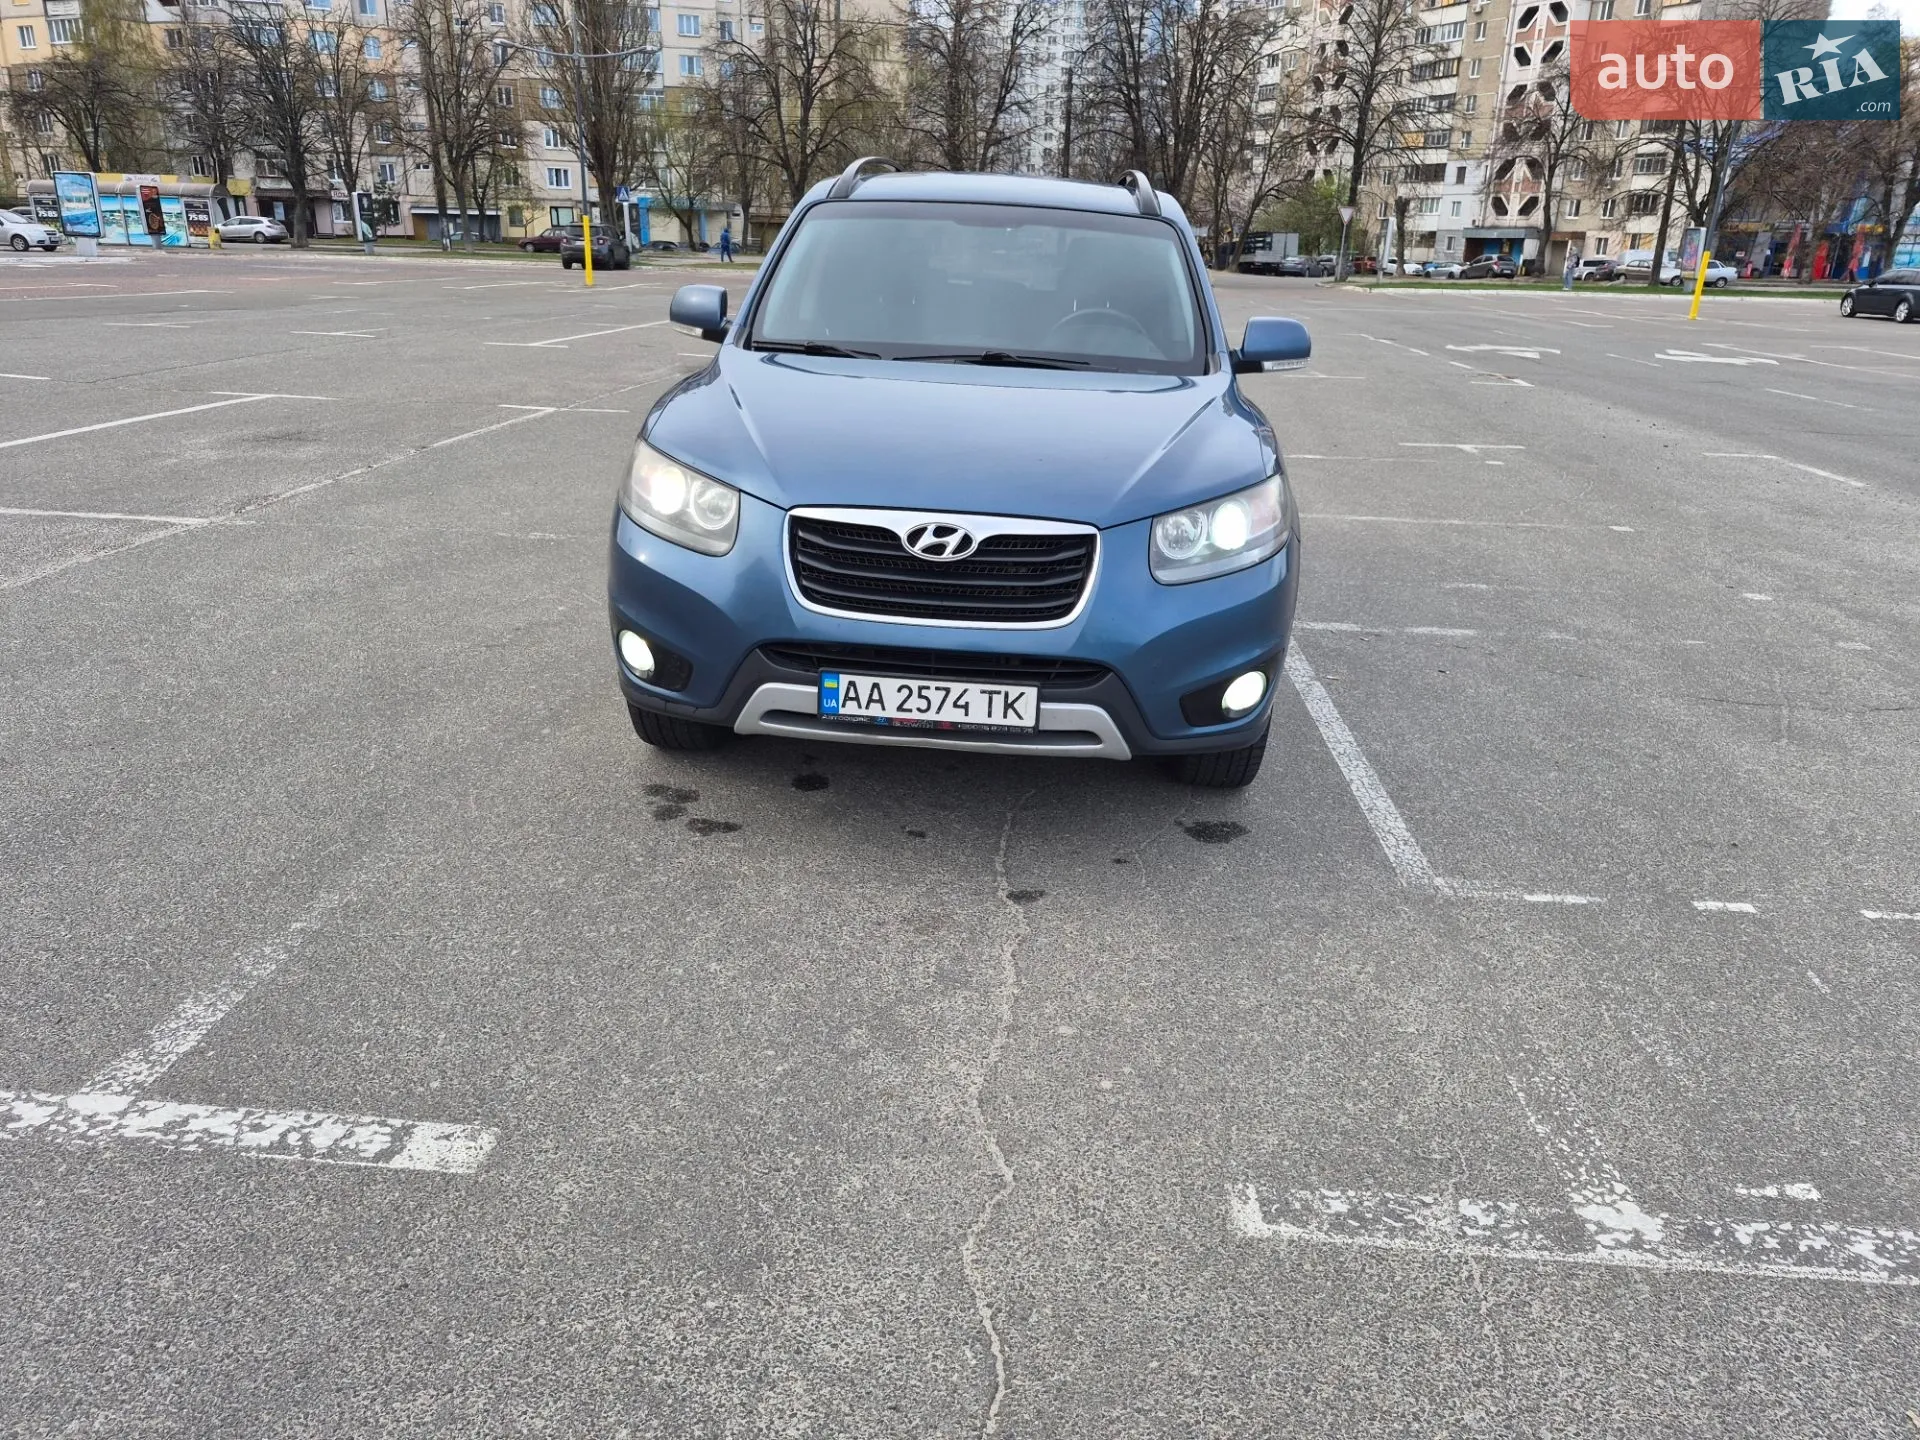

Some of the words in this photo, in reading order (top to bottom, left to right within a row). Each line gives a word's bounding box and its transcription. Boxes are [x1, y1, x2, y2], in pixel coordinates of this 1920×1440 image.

[823, 698, 838, 708] UA
[841, 680, 887, 712] AA
[896, 684, 970, 717] 2574
[980, 689, 1027, 721] TK
